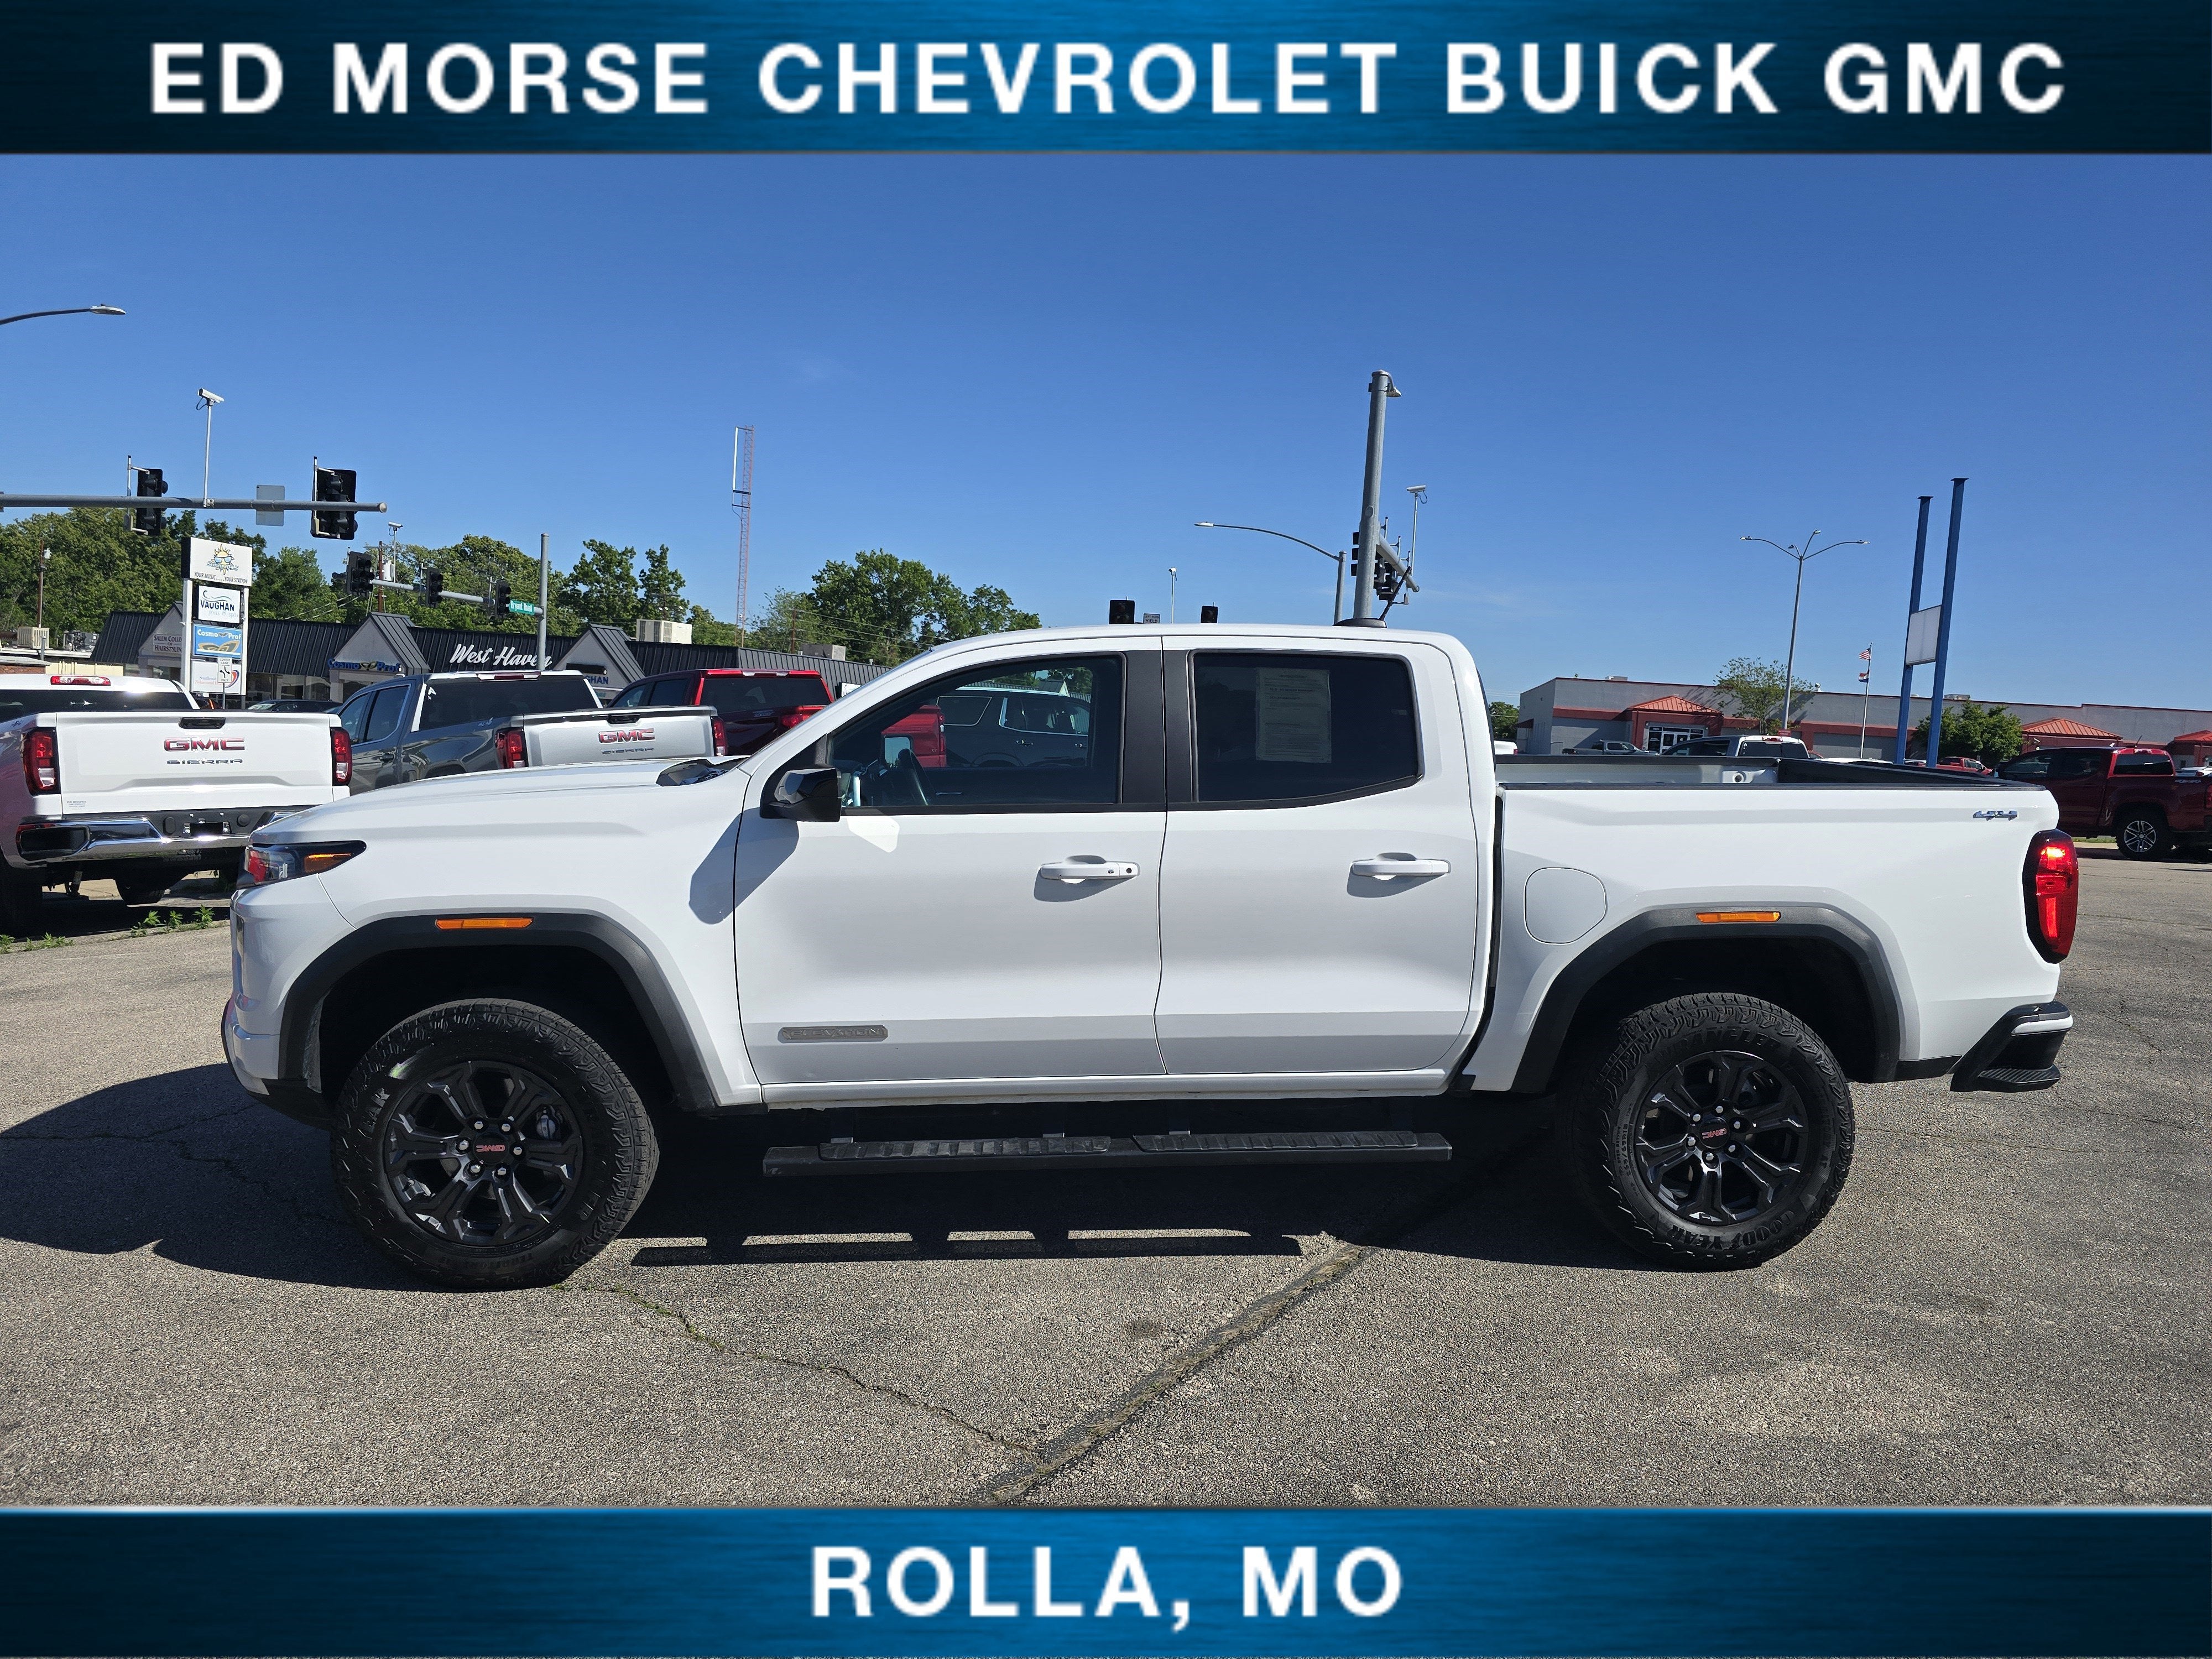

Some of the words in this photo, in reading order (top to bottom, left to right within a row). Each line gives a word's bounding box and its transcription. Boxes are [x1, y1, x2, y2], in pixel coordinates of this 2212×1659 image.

[200, 599, 234, 612] VAUGHAN
[510, 600, 523, 612] Bryant
[523, 602, 533, 612] Road
[197, 629, 218, 638] Cosmo
[449, 643, 493, 664] West
[327, 658, 361, 670] Cosmo
[377, 661, 401, 672] Prof
[585, 675, 609, 685] GHAN
[598, 728, 655, 744] GMC
[163, 737, 245, 752] GMC
[790, 1028, 882, 1037] ELEVATION
[1702, 1128, 1727, 1139] GMC
